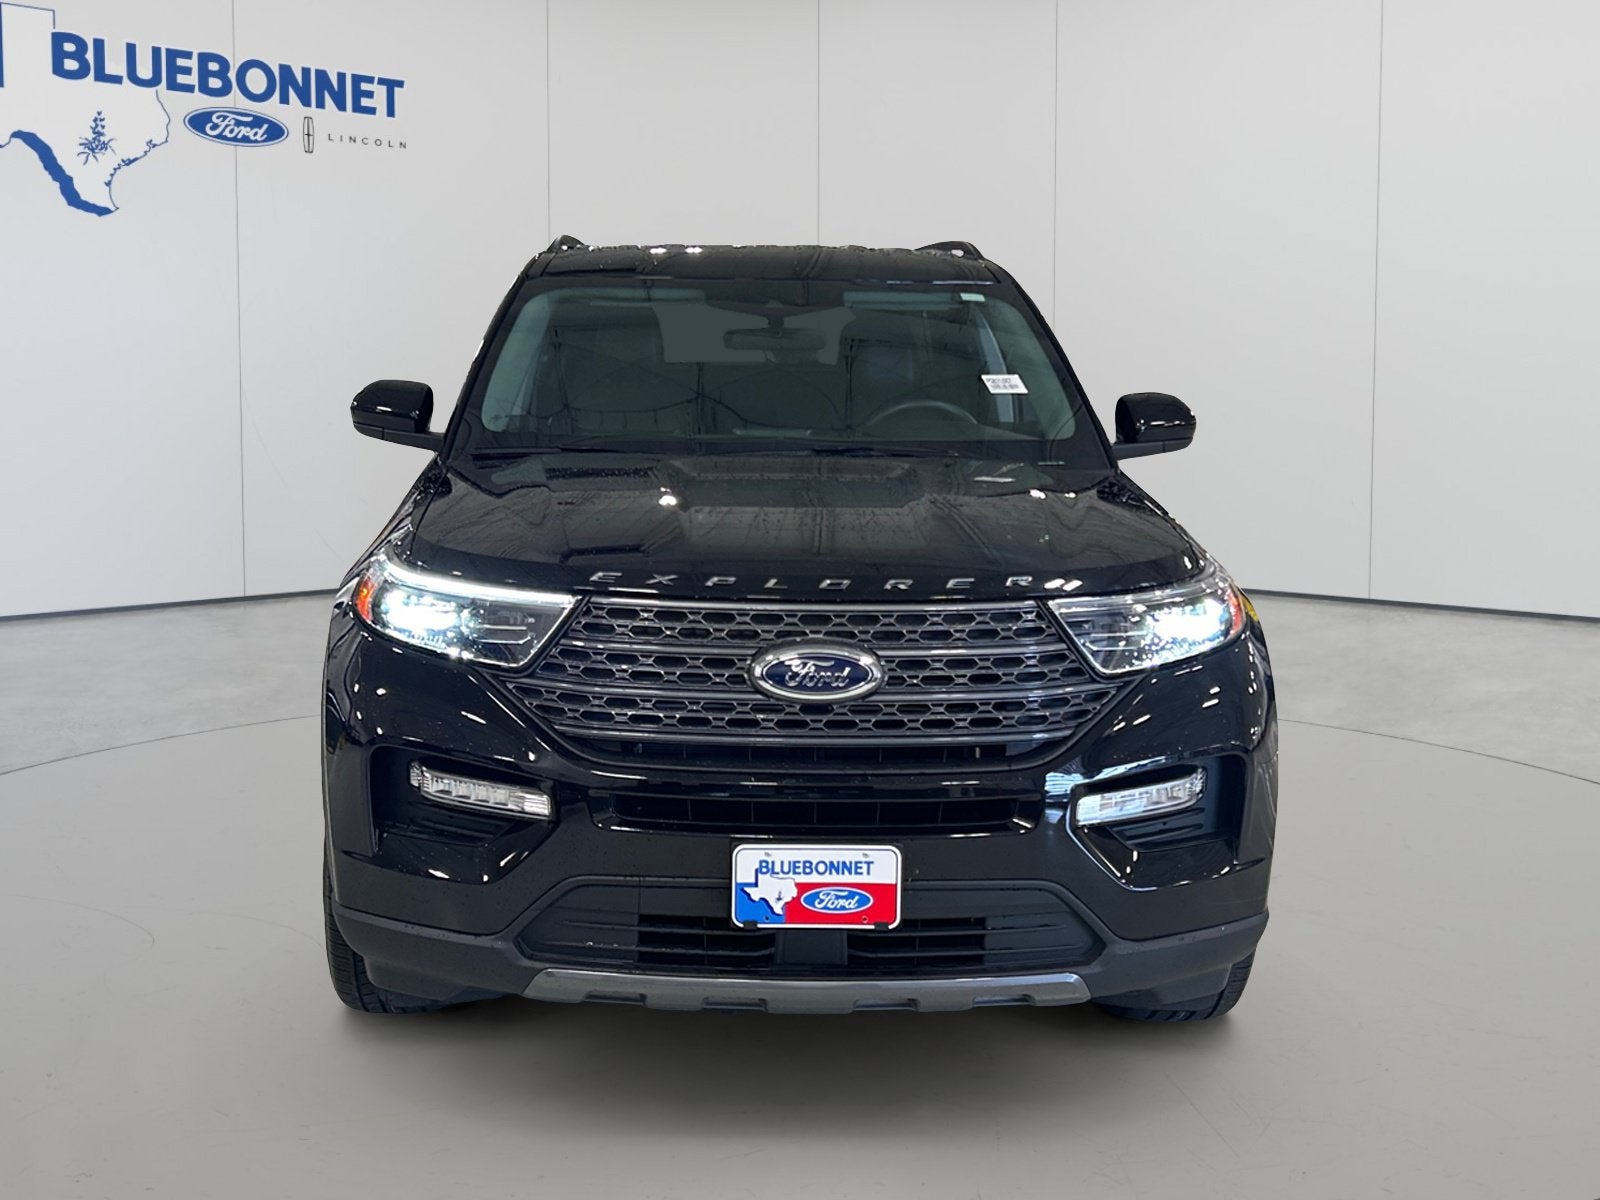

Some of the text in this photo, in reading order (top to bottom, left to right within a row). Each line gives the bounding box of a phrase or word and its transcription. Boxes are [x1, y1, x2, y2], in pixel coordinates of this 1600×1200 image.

[51, 31, 405, 118] BLUEBONNET
[205, 112, 268, 142] Ford
[328, 133, 407, 149] LINCOLN
[588, 571, 1034, 591] EXPLORER
[783, 657, 852, 688] Ford
[758, 859, 875, 876] BLUEBONNET
[814, 889, 859, 909] Ford
